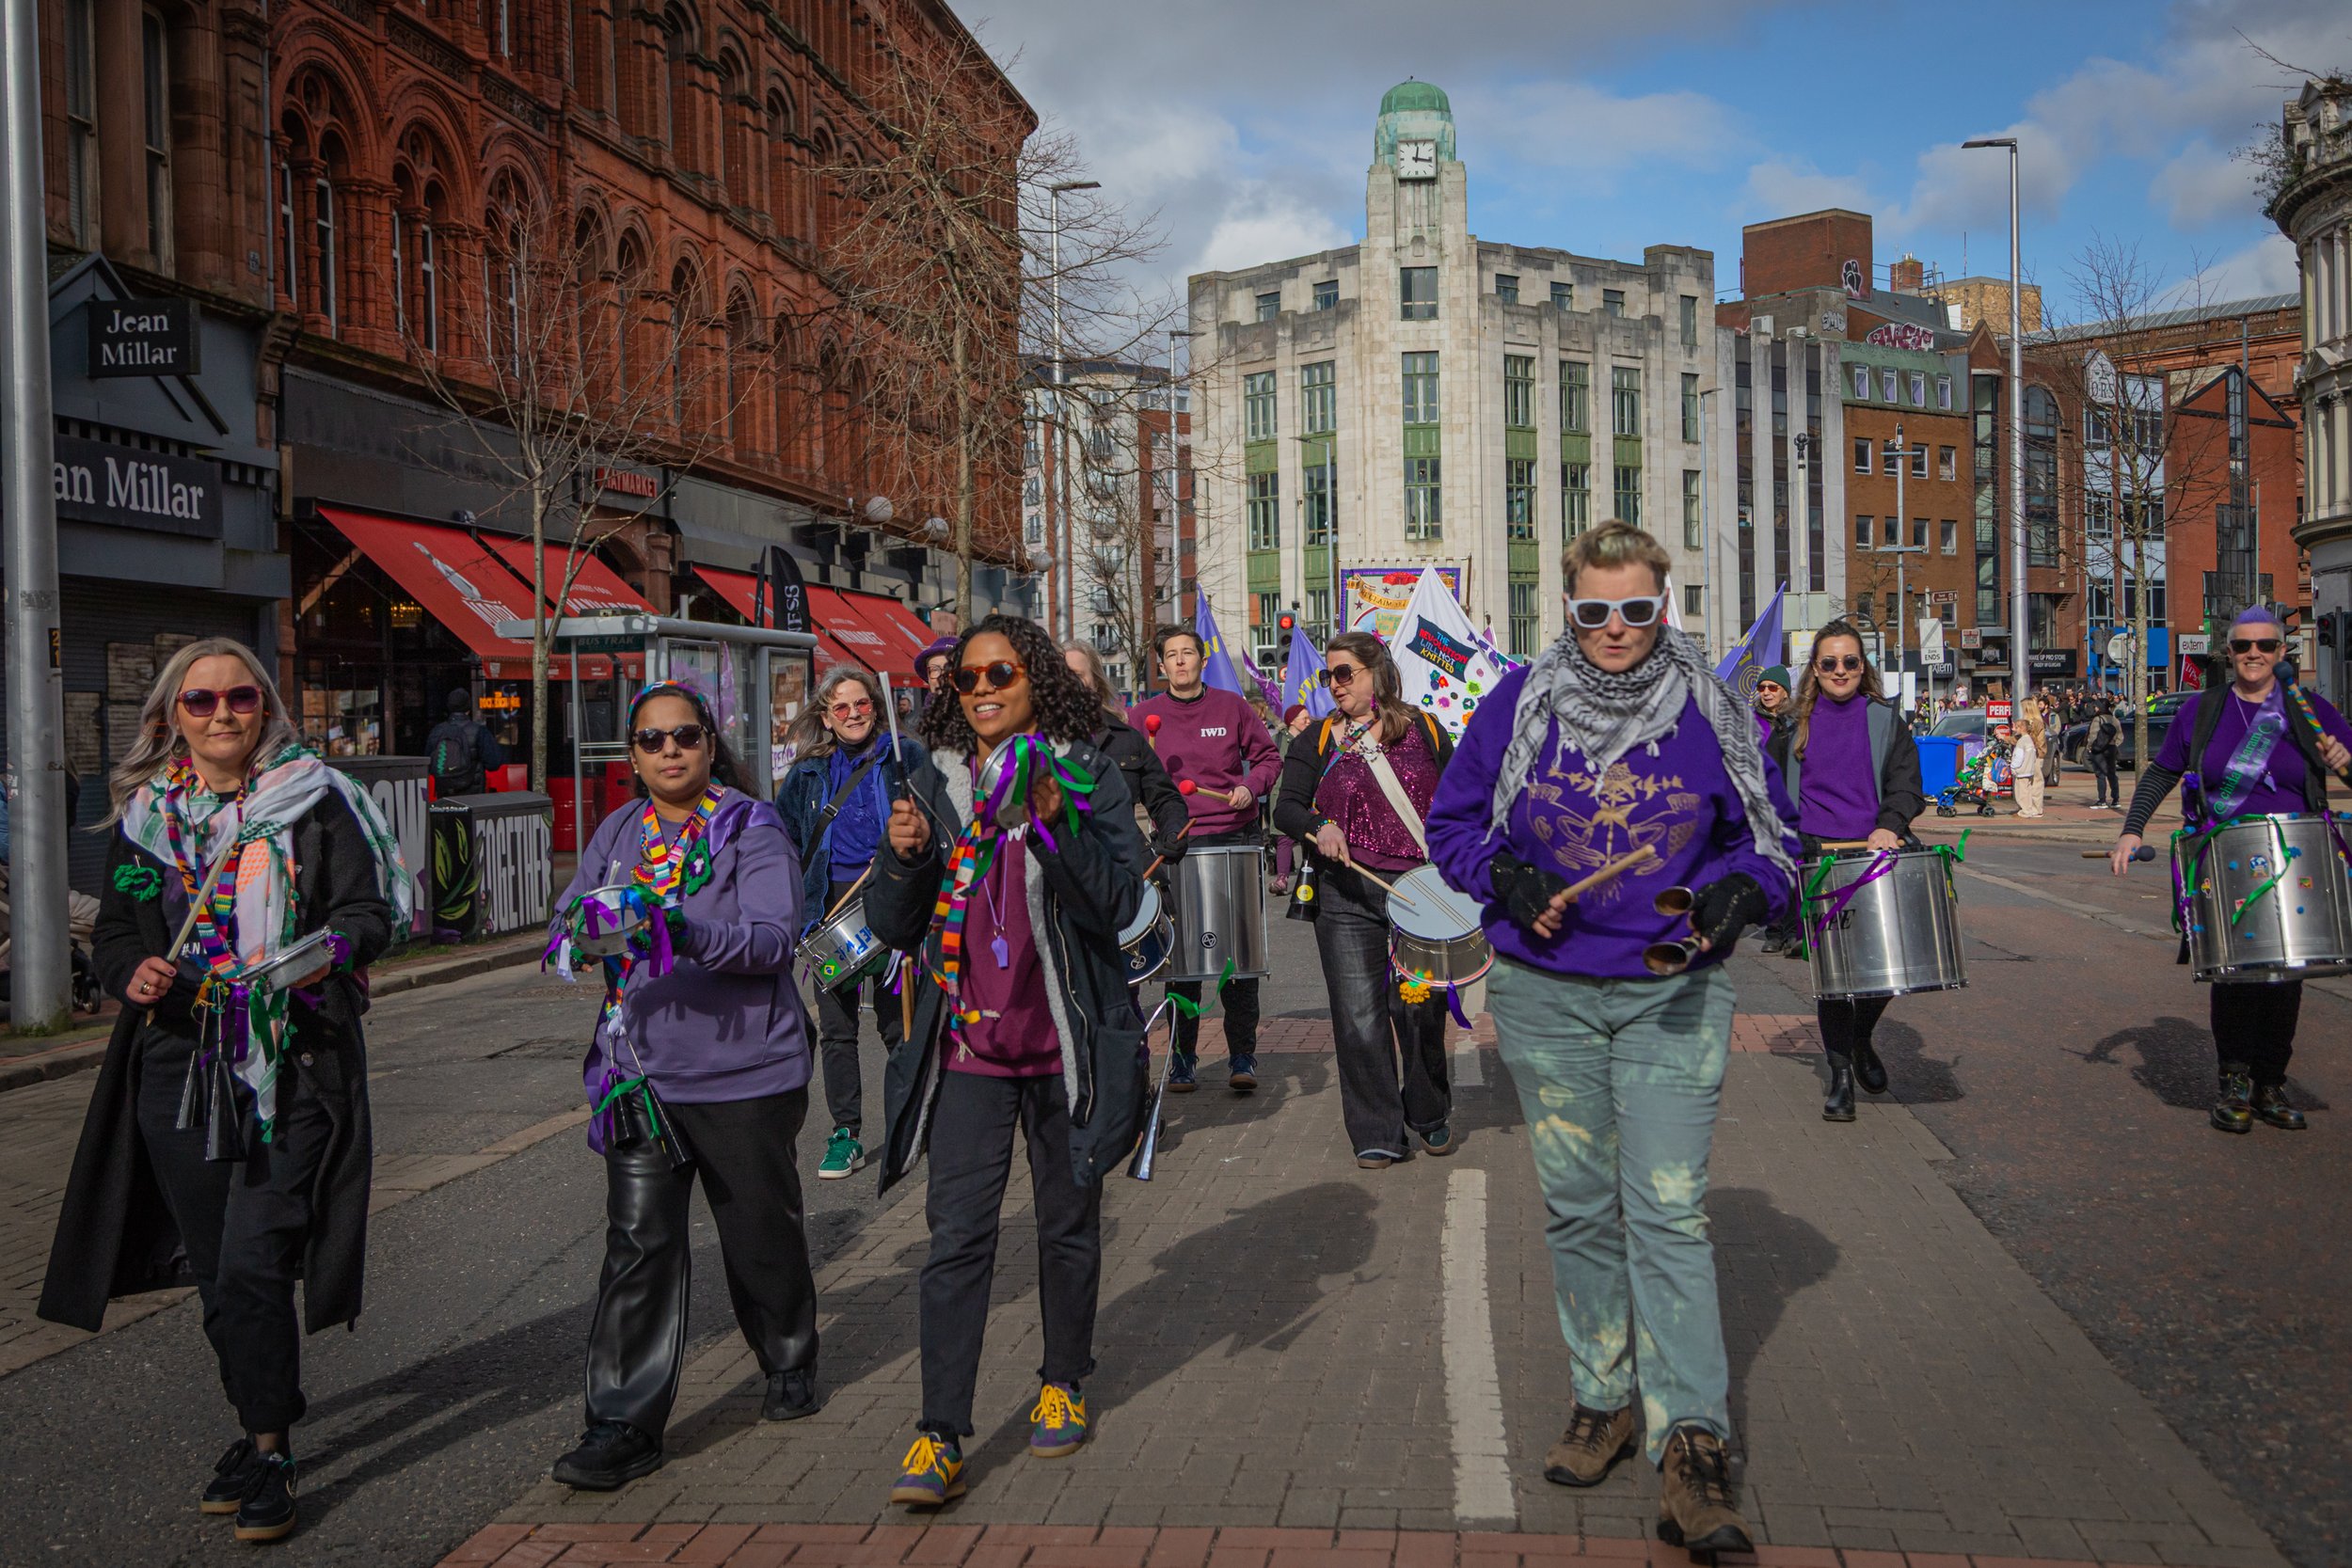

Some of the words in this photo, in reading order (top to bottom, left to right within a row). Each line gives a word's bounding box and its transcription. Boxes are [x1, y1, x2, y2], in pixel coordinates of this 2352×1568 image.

[106, 309, 170, 334] Jean
[101, 342, 177, 366] Millar
[54, 461, 96, 505] an
[105, 456, 204, 520] Millar
[1360, 590, 1392, 608] RECLAIM
[578, 637, 601, 646] BUS
[603, 635, 634, 645] TRAK
[1419, 628, 1469, 664] REVOLUTION
[1437, 631, 1451, 646] THE
[2182, 638, 2204, 652] extern
[1420, 640, 1438, 655] WILL
[1438, 652, 1455, 665] NOT
[1454, 661, 1465, 673] BE
[1421, 648, 1454, 674] KNITTED
[1200, 727, 1227, 737] IWD
[475, 814, 552, 933] TOGETHER
